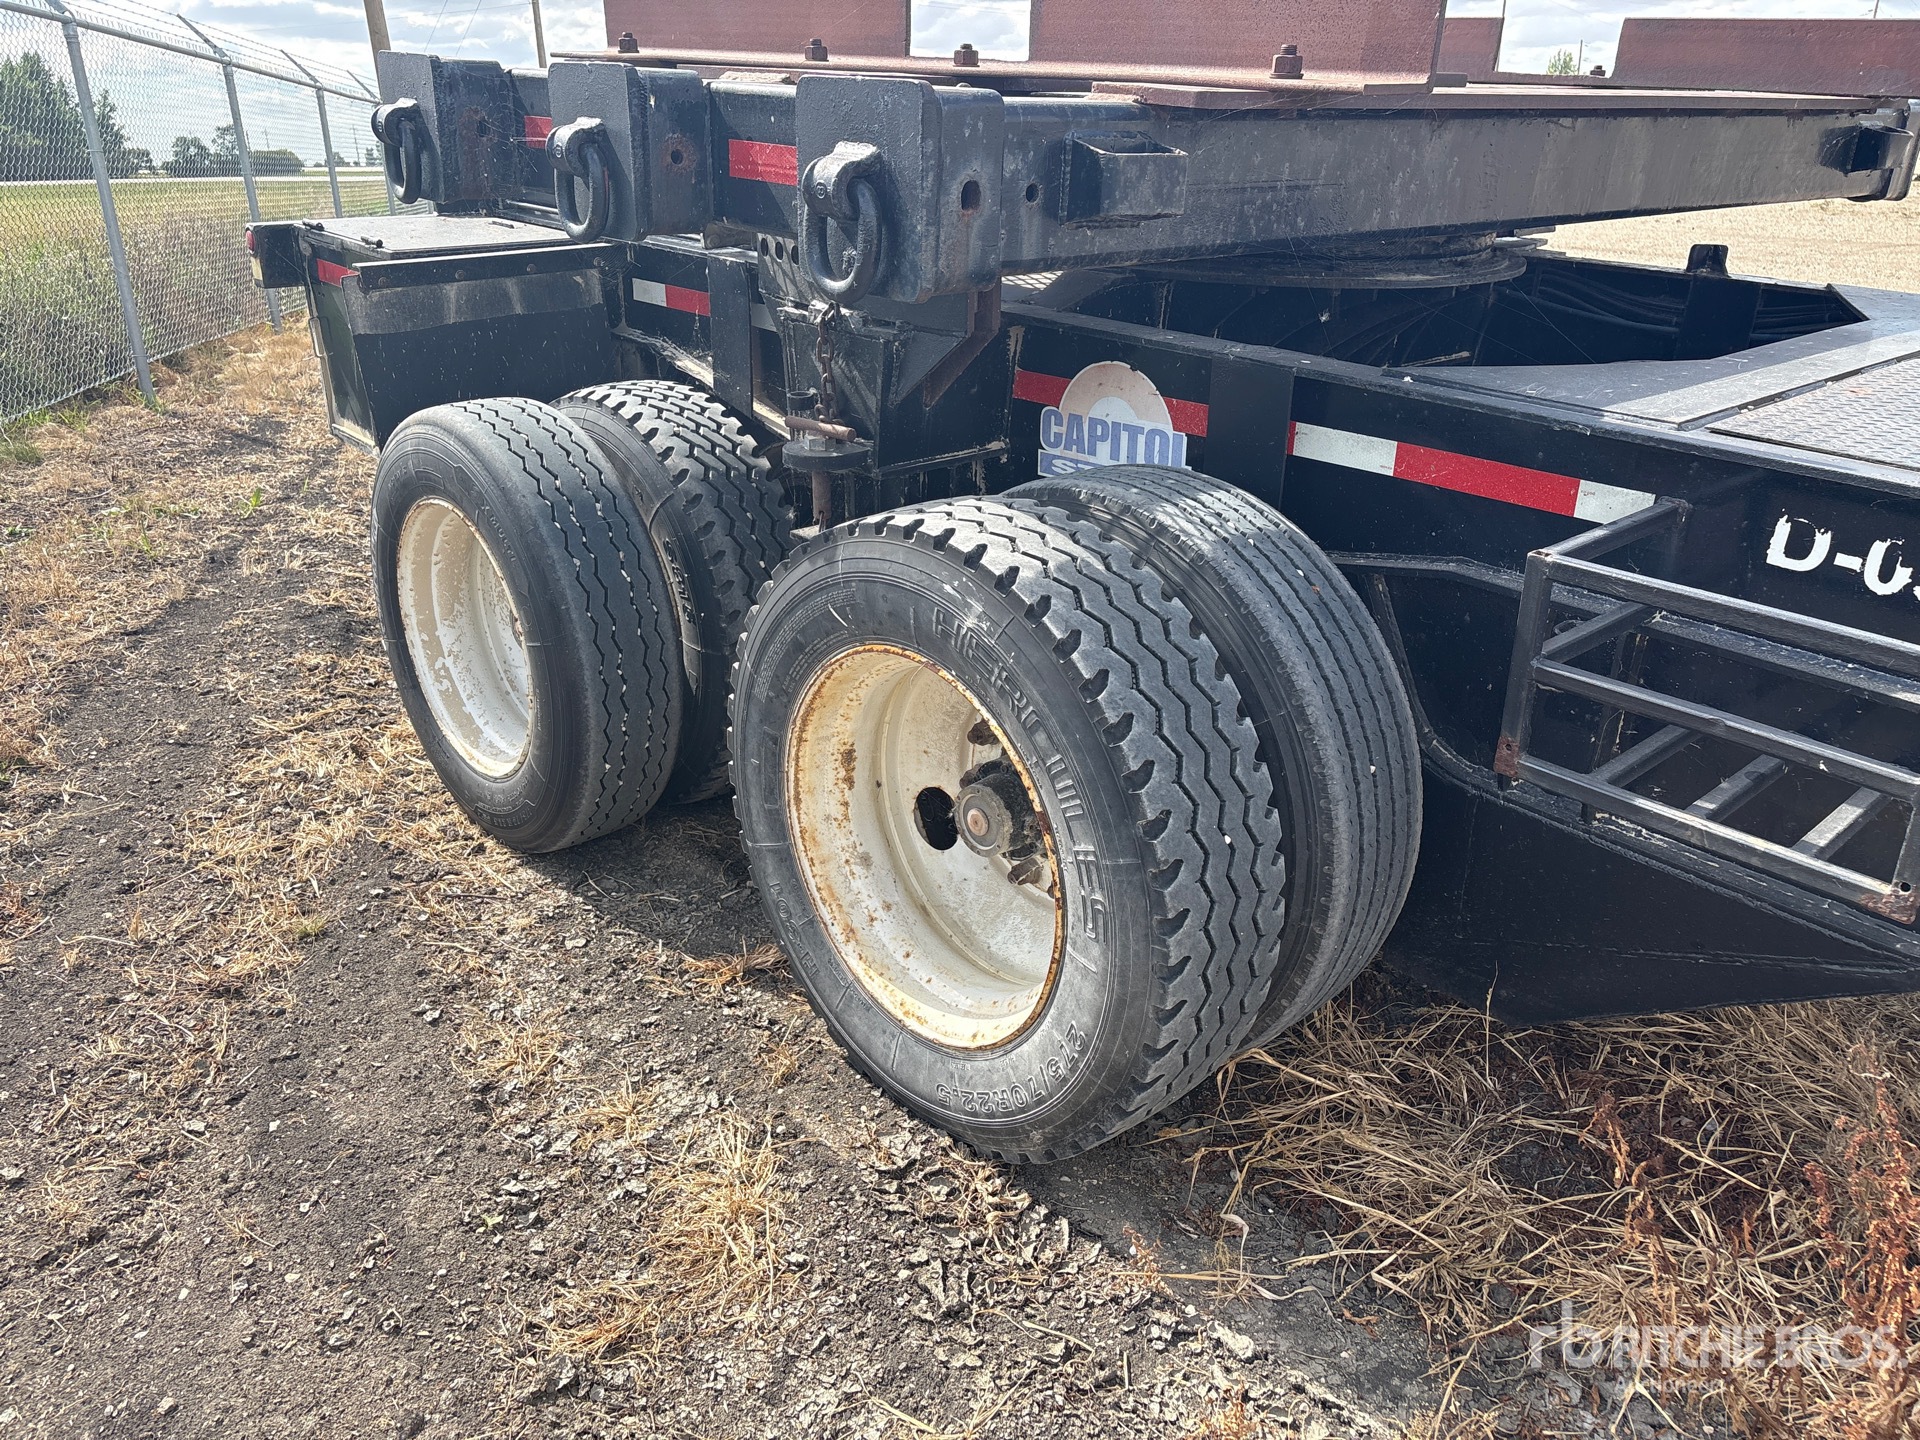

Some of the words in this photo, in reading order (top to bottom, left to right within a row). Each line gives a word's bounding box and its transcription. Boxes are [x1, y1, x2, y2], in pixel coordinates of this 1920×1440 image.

[1766, 513, 1920, 601] D-0
[932, 606, 1107, 944] HERCULES
[936, 1020, 1086, 1114] 275/70R22.5
